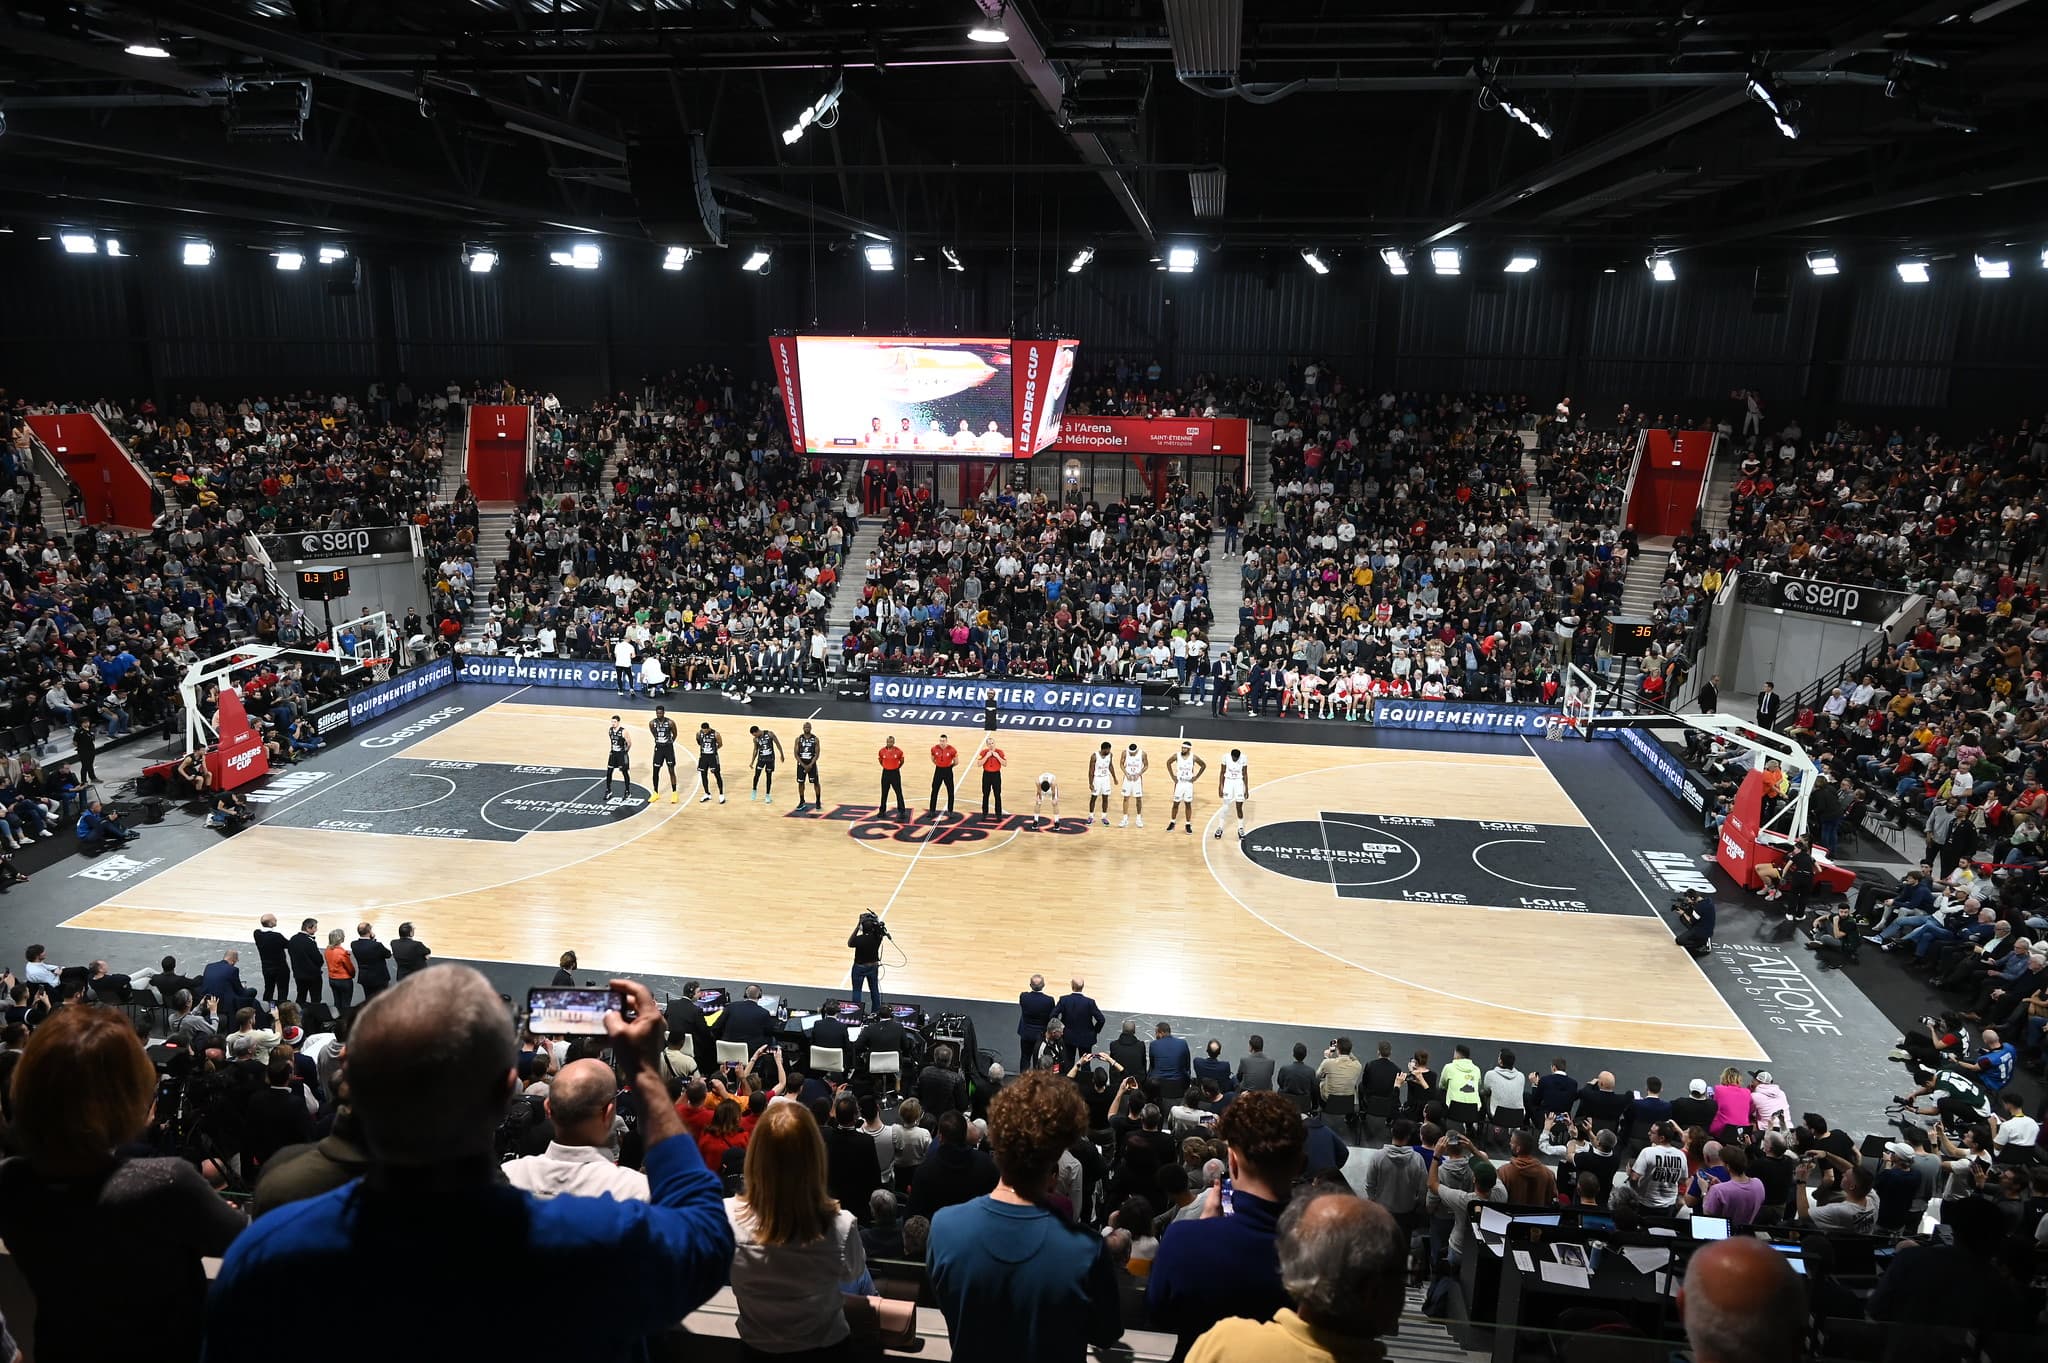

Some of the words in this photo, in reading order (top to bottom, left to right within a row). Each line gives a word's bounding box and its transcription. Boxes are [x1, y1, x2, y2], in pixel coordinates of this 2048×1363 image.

[780, 343, 790, 375] CUP
[1027, 346, 1039, 381] CUP
[784, 378, 802, 447] LEADERS
[1019, 380, 1036, 452] LEADERS
[496, 414, 506, 426] H
[1065, 422, 1072, 432] à
[1163, 440, 1193, 448] métropole
[1673, 439, 1684, 453] E
[322, 531, 369, 554] serp
[1805, 584, 1859, 616] serp
[461, 663, 582, 681] EQUIPEMENTIER
[351, 682, 417, 717] EQUIPEMENTIER
[419, 665, 452, 687] OFFICIEL
[873, 682, 1034, 704] EQUIPEMENTIER
[1044, 691, 1137, 709] OFFICIEL
[1379, 707, 1526, 728] EQUIPEMENTIER
[227, 746, 262, 768] LEADERS
[236, 757, 252, 771] CUP
[1658, 759, 1684, 790] OFFICIEL
[501, 798, 620, 811] SAINT-ÉTIENNE
[531, 805, 612, 816] métropole
[783, 802, 1088, 835] LEADERS
[1378, 815, 1435, 825] Loire
[412, 825, 468, 835] Loire
[1479, 821, 1537, 831] Loire
[847, 822, 990, 845] CUP
[1252, 845, 1386, 859] SAINT-ÉTIENNE
[1722, 833, 1745, 859] LEADERS
[1726, 846, 1737, 859] CUP
[1295, 853, 1387, 865] métropole
[1402, 889, 1467, 901] Loire
[1520, 897, 1587, 909] Loire
[1711, 942, 1782, 953] CABINET
[1715, 951, 1793, 1033] immobilier
[1655, 1155, 1682, 1169] DAVID
